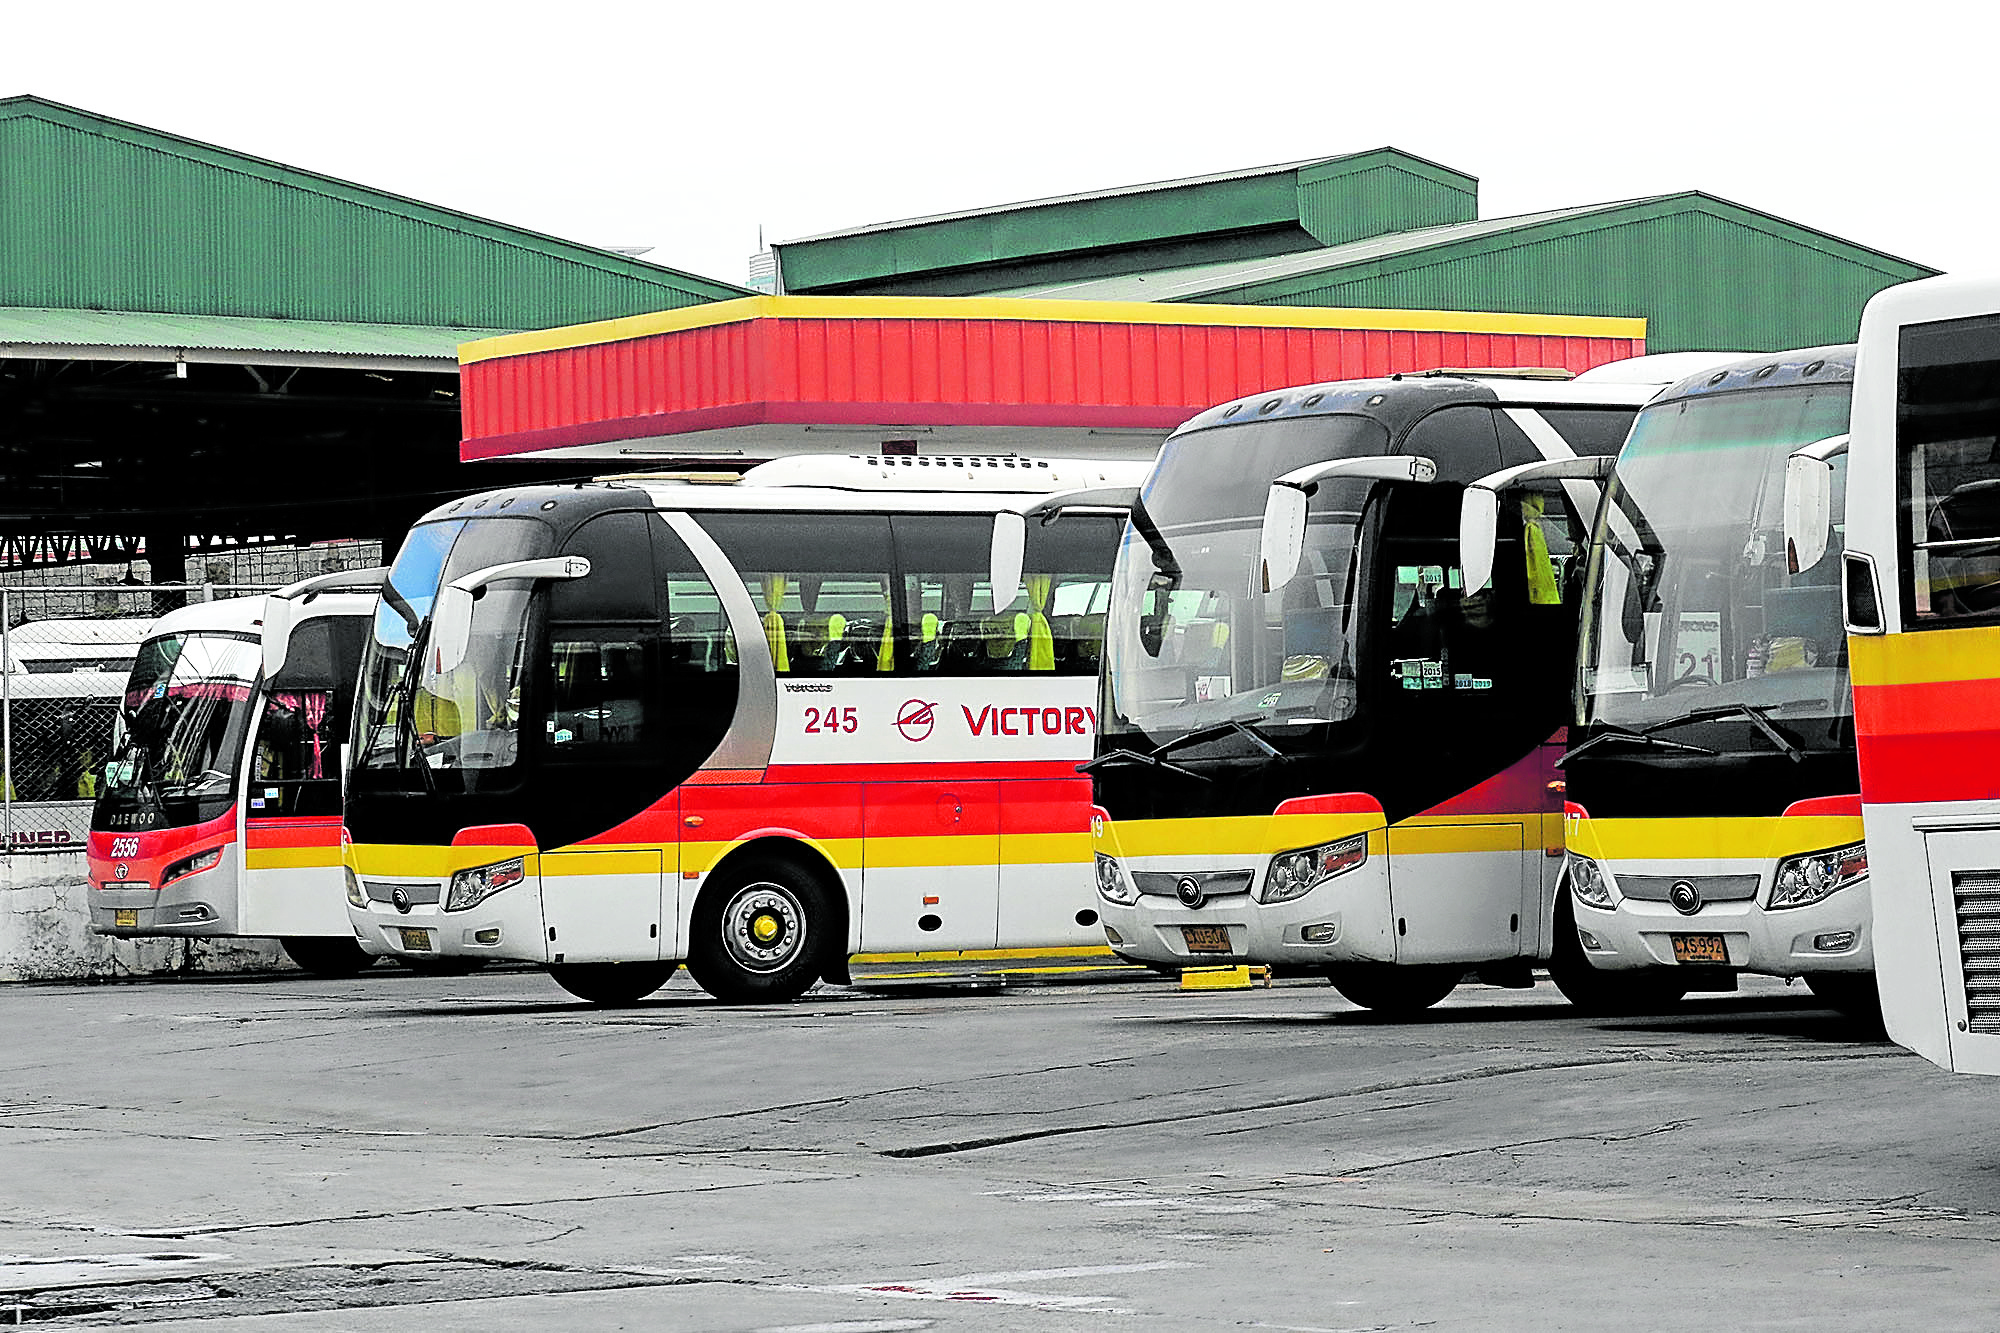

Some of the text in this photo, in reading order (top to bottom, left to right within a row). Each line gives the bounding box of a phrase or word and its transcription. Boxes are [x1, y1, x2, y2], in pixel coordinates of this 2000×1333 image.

[1424, 668, 1441, 676] 2015
[1474, 680, 1491, 688] 2019
[804, 706, 858, 733] 245
[110, 812, 155, 826] DAEWOO
[110, 837, 140, 858] 2556
